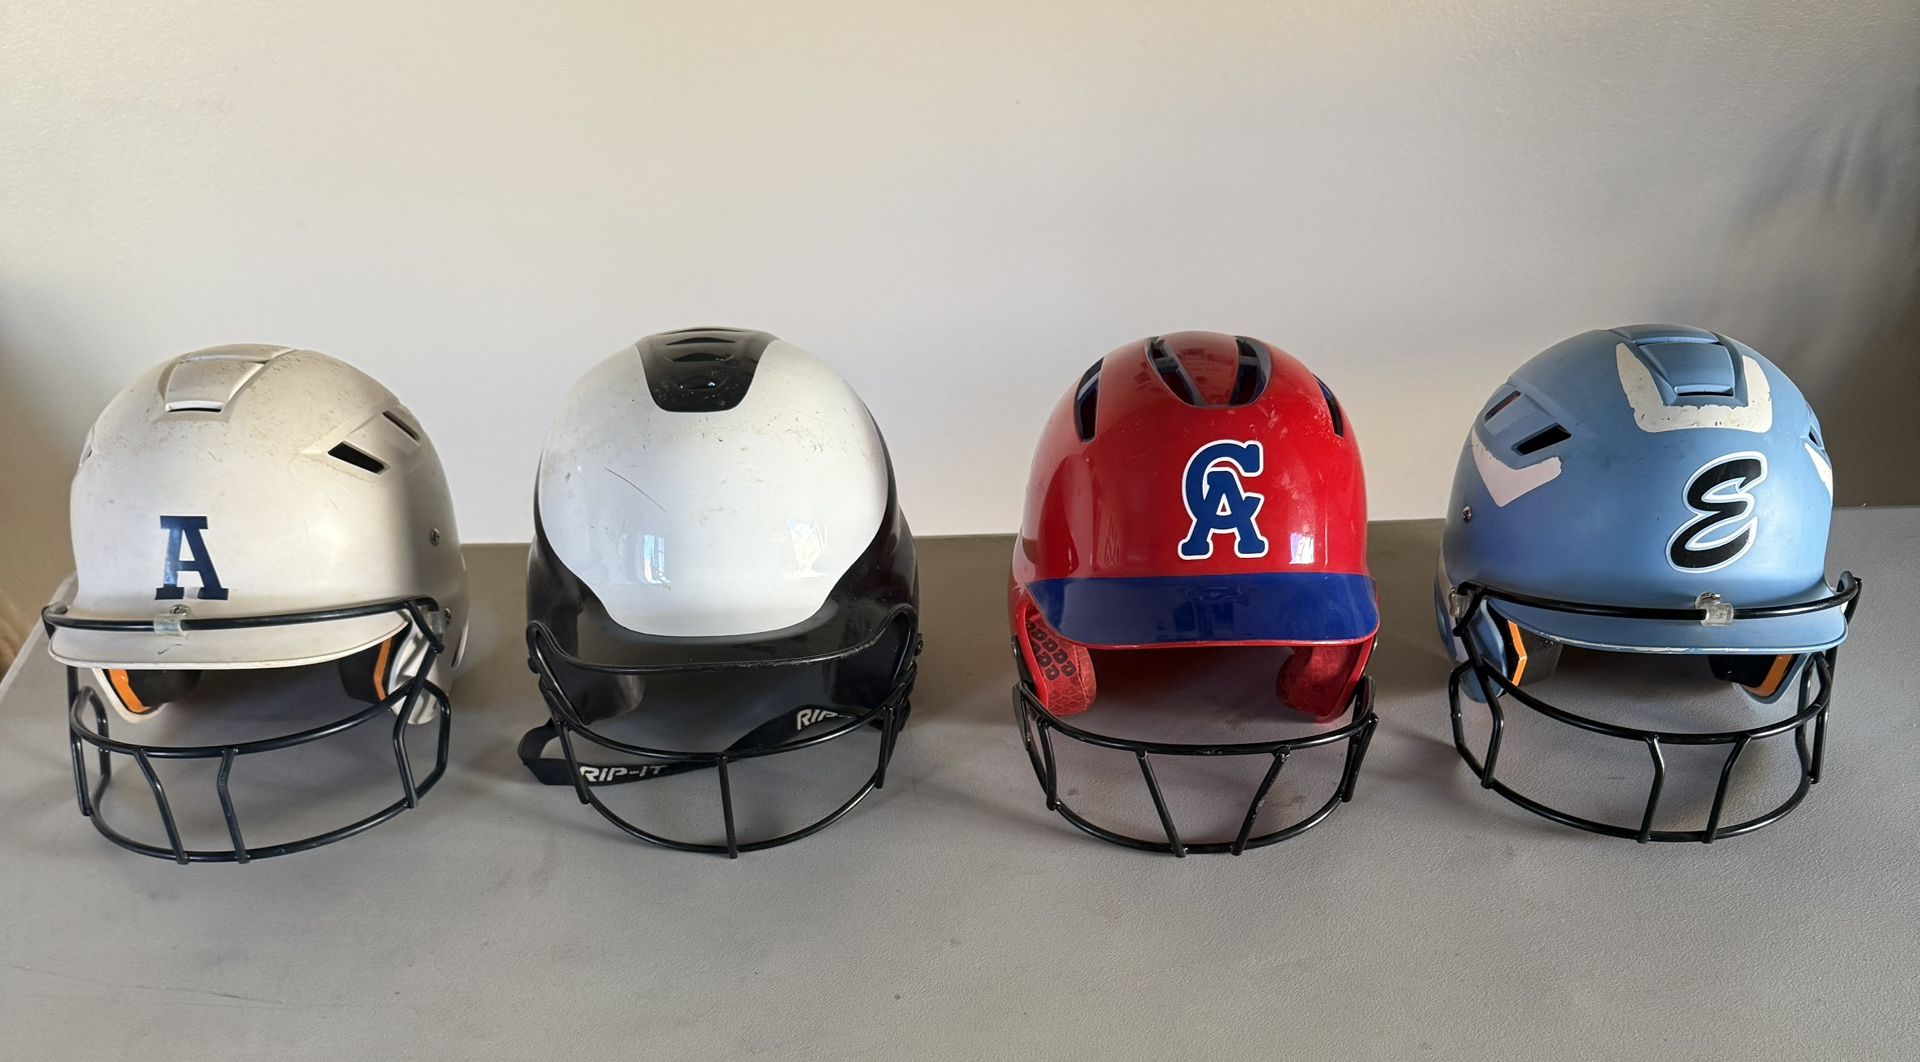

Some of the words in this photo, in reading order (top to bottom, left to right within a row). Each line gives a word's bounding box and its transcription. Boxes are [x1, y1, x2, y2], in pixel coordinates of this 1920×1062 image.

[1178, 439, 1268, 561] CA
[1665, 451, 1768, 573] E
[155, 516, 229, 600] A
[796, 708, 852, 731] RIP
[580, 765, 668, 782] RIP-IT
